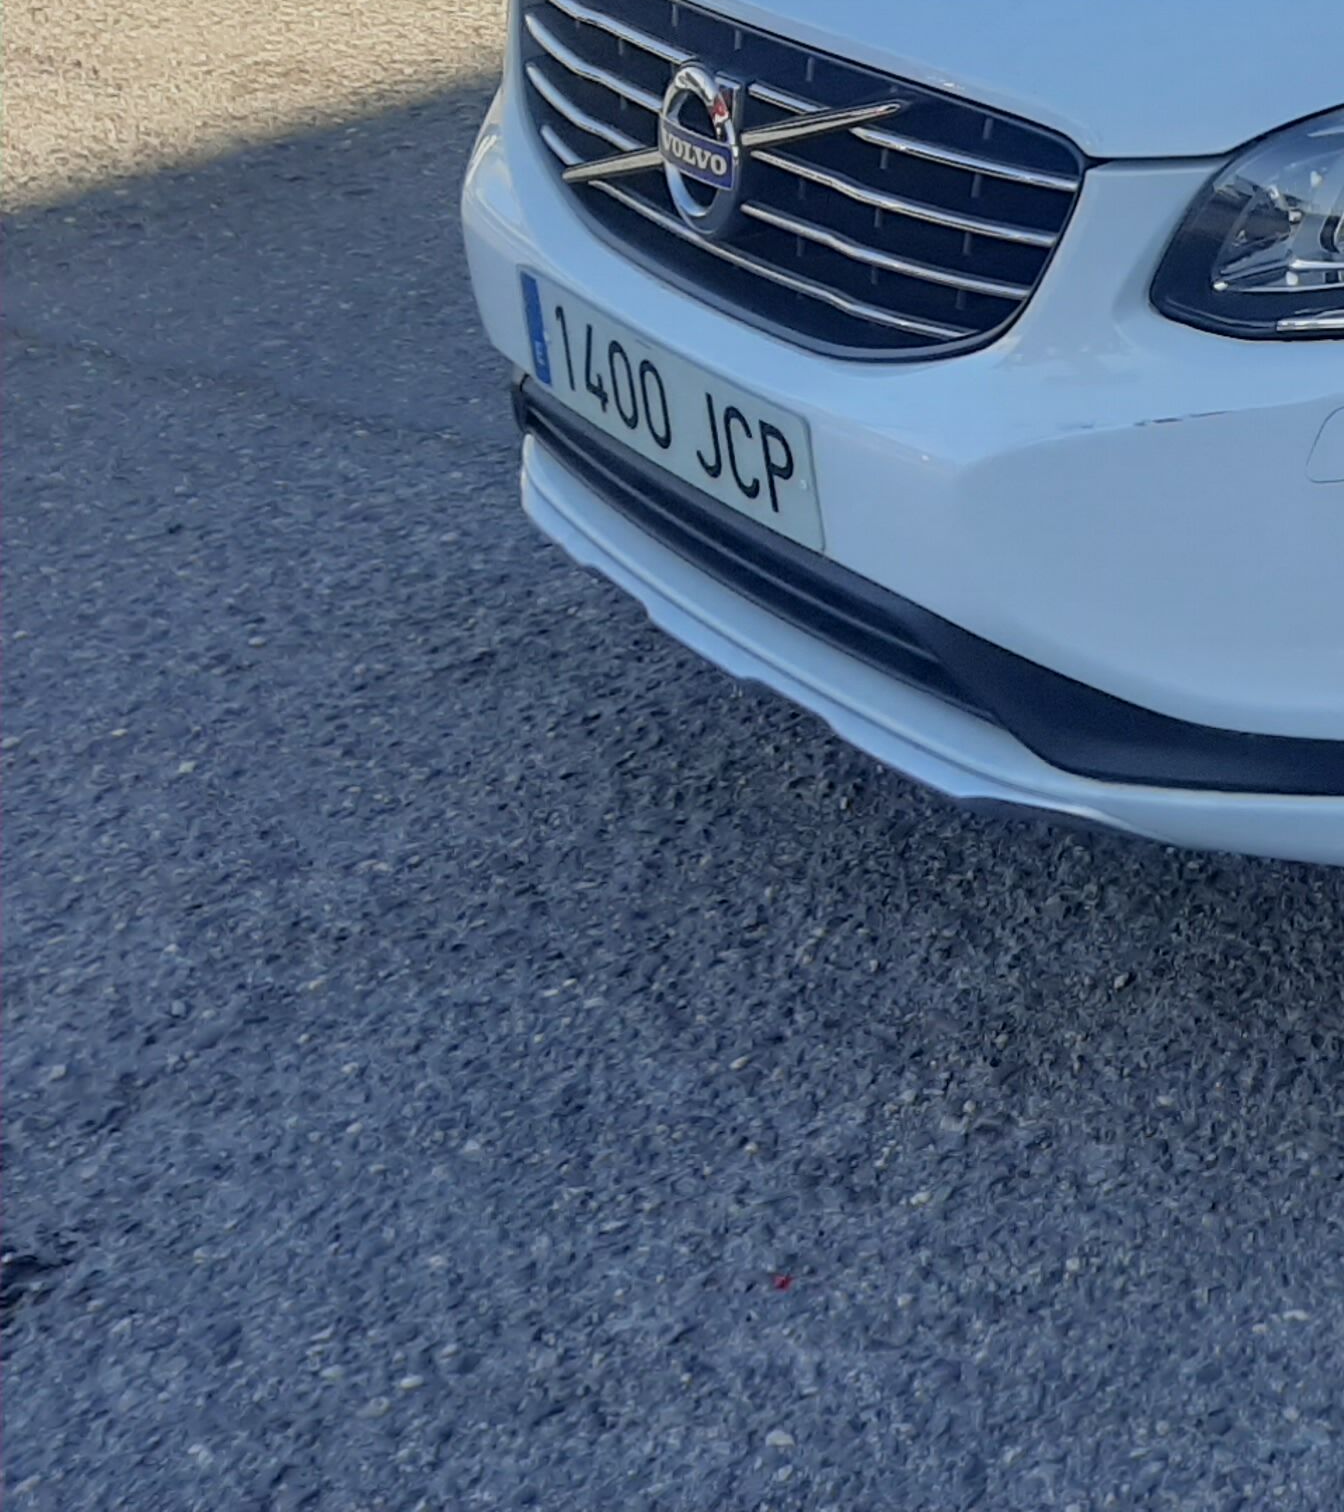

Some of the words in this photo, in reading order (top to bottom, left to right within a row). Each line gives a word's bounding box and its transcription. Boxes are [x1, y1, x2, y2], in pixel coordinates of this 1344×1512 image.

[662, 129, 728, 175] VOLVO
[555, 305, 672, 450] 1400
[696, 391, 795, 513] JCP
